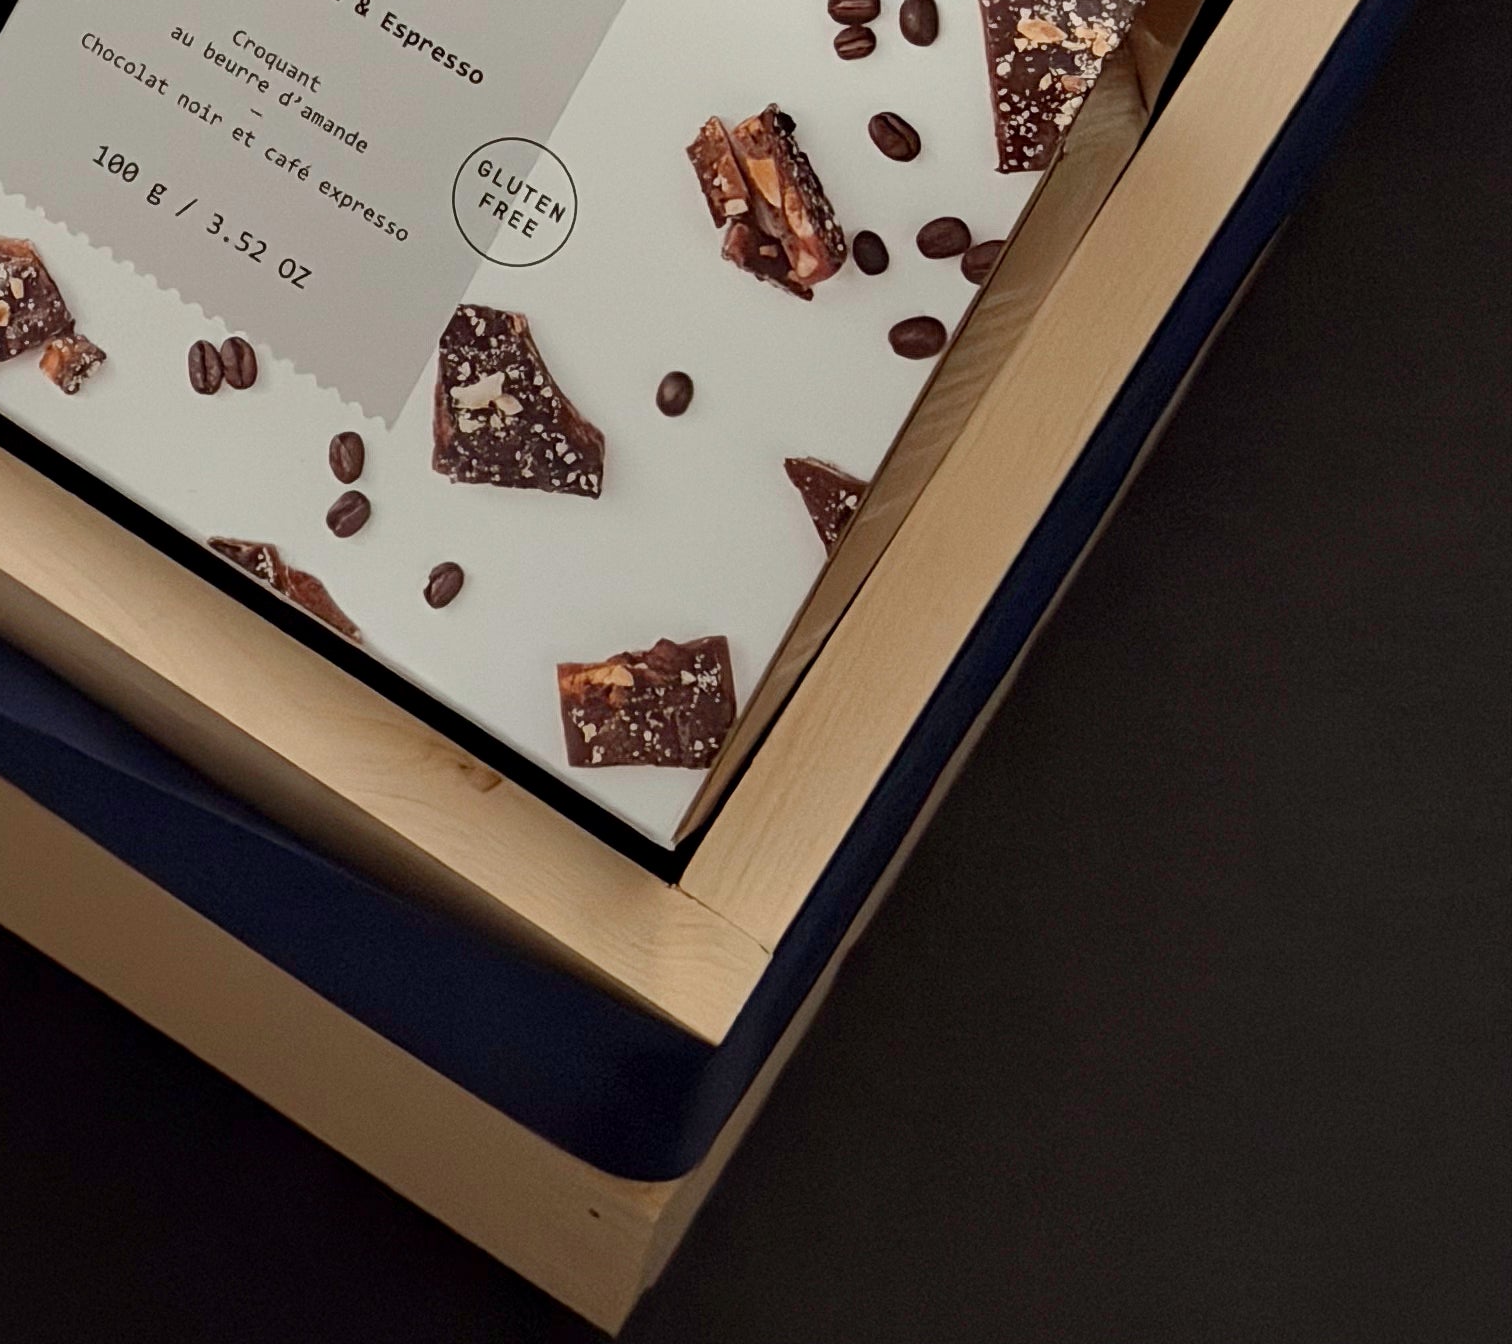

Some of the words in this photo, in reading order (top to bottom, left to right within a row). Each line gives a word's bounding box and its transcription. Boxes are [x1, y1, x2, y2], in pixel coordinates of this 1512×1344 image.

[230, 27, 323, 94] Croquant
[380, 10, 485, 87] Espresso
[169, 24, 195, 47] au
[201, 41, 270, 95] beurre
[278, 89, 369, 156] d'amande
[80, 32, 169, 97] Chocolat
[175, 91, 223, 129] noir
[230, 124, 256, 148] et
[263, 144, 312, 182] café
[317, 177, 411, 243] expresso
[91, 143, 141, 184] 100
[144, 180, 169, 208] g
[174, 197, 198, 218] /
[204, 212, 269, 264] 3.52
[277, 255, 314, 290] OZ
[476, 158, 567, 225] GLUTEN
[477, 192, 541, 239] FREE
